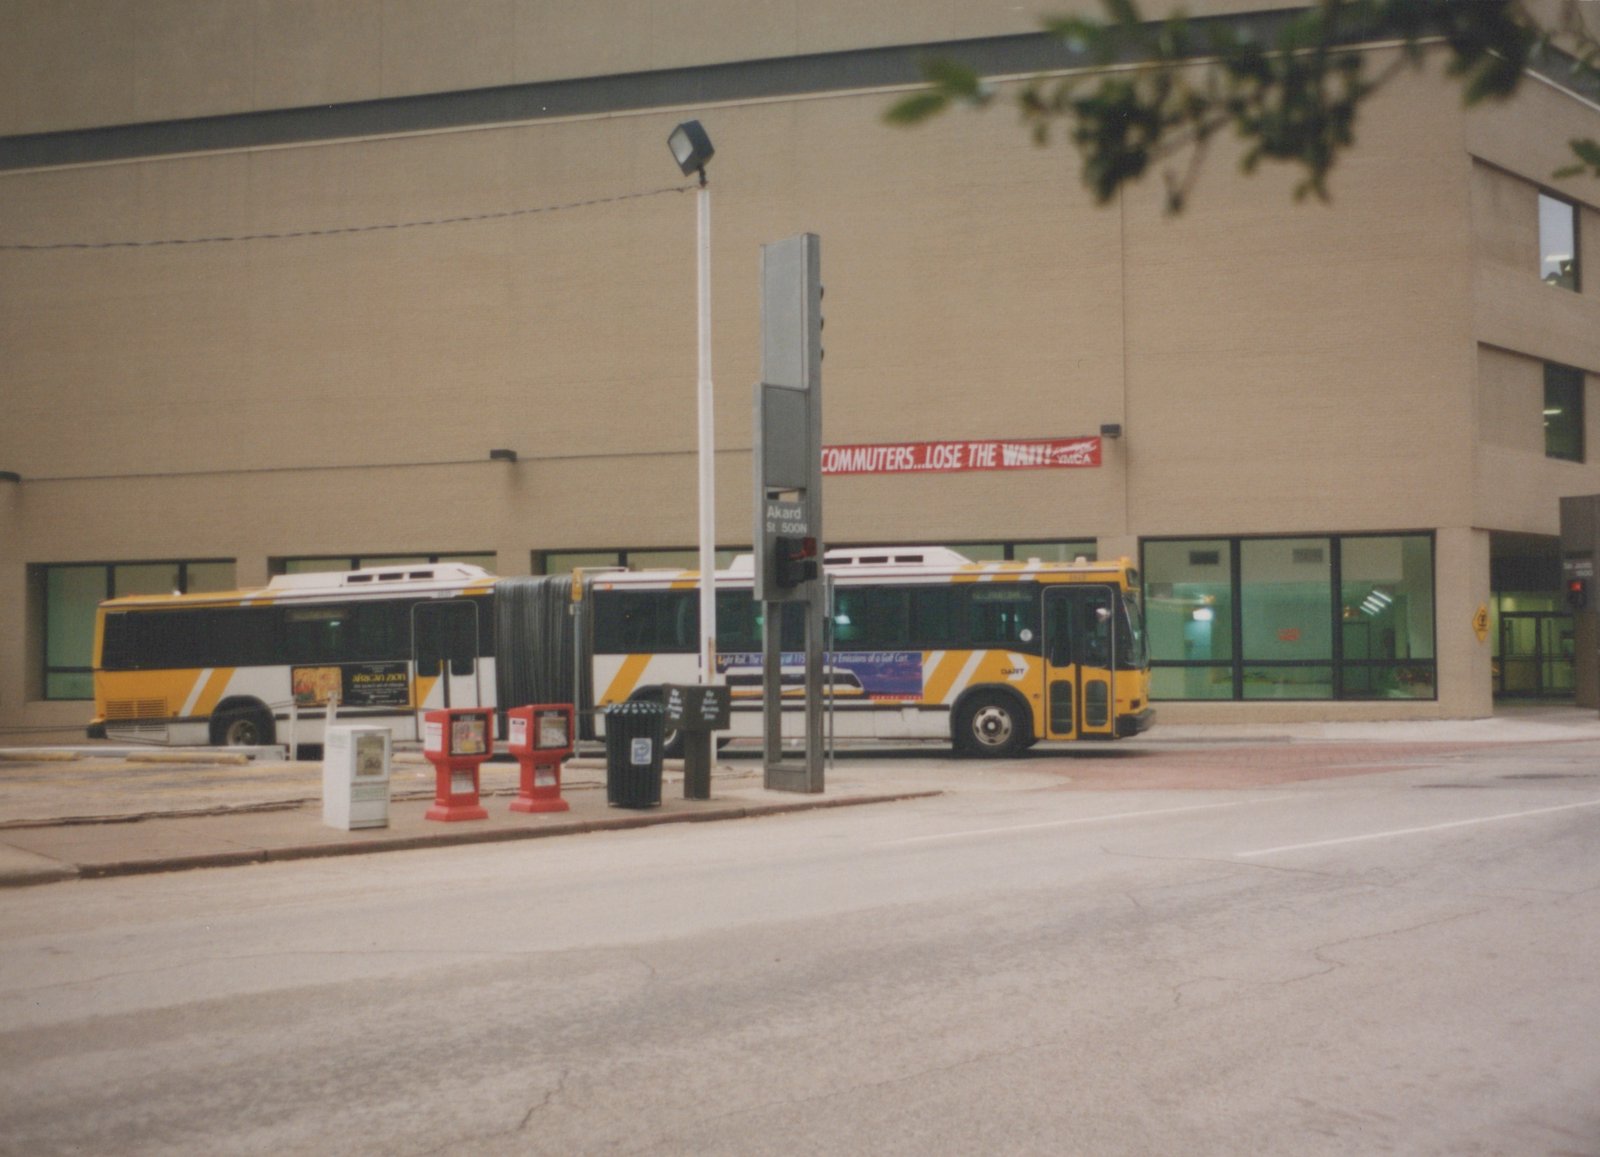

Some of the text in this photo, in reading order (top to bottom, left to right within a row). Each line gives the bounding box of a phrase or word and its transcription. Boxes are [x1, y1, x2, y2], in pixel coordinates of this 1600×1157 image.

[968, 444, 997, 467] THE
[1057, 454, 1092, 465] YMCA
[767, 505, 801, 520] Akard
[823, 653, 837, 663] Te
[838, 653, 867, 663] Emissions
